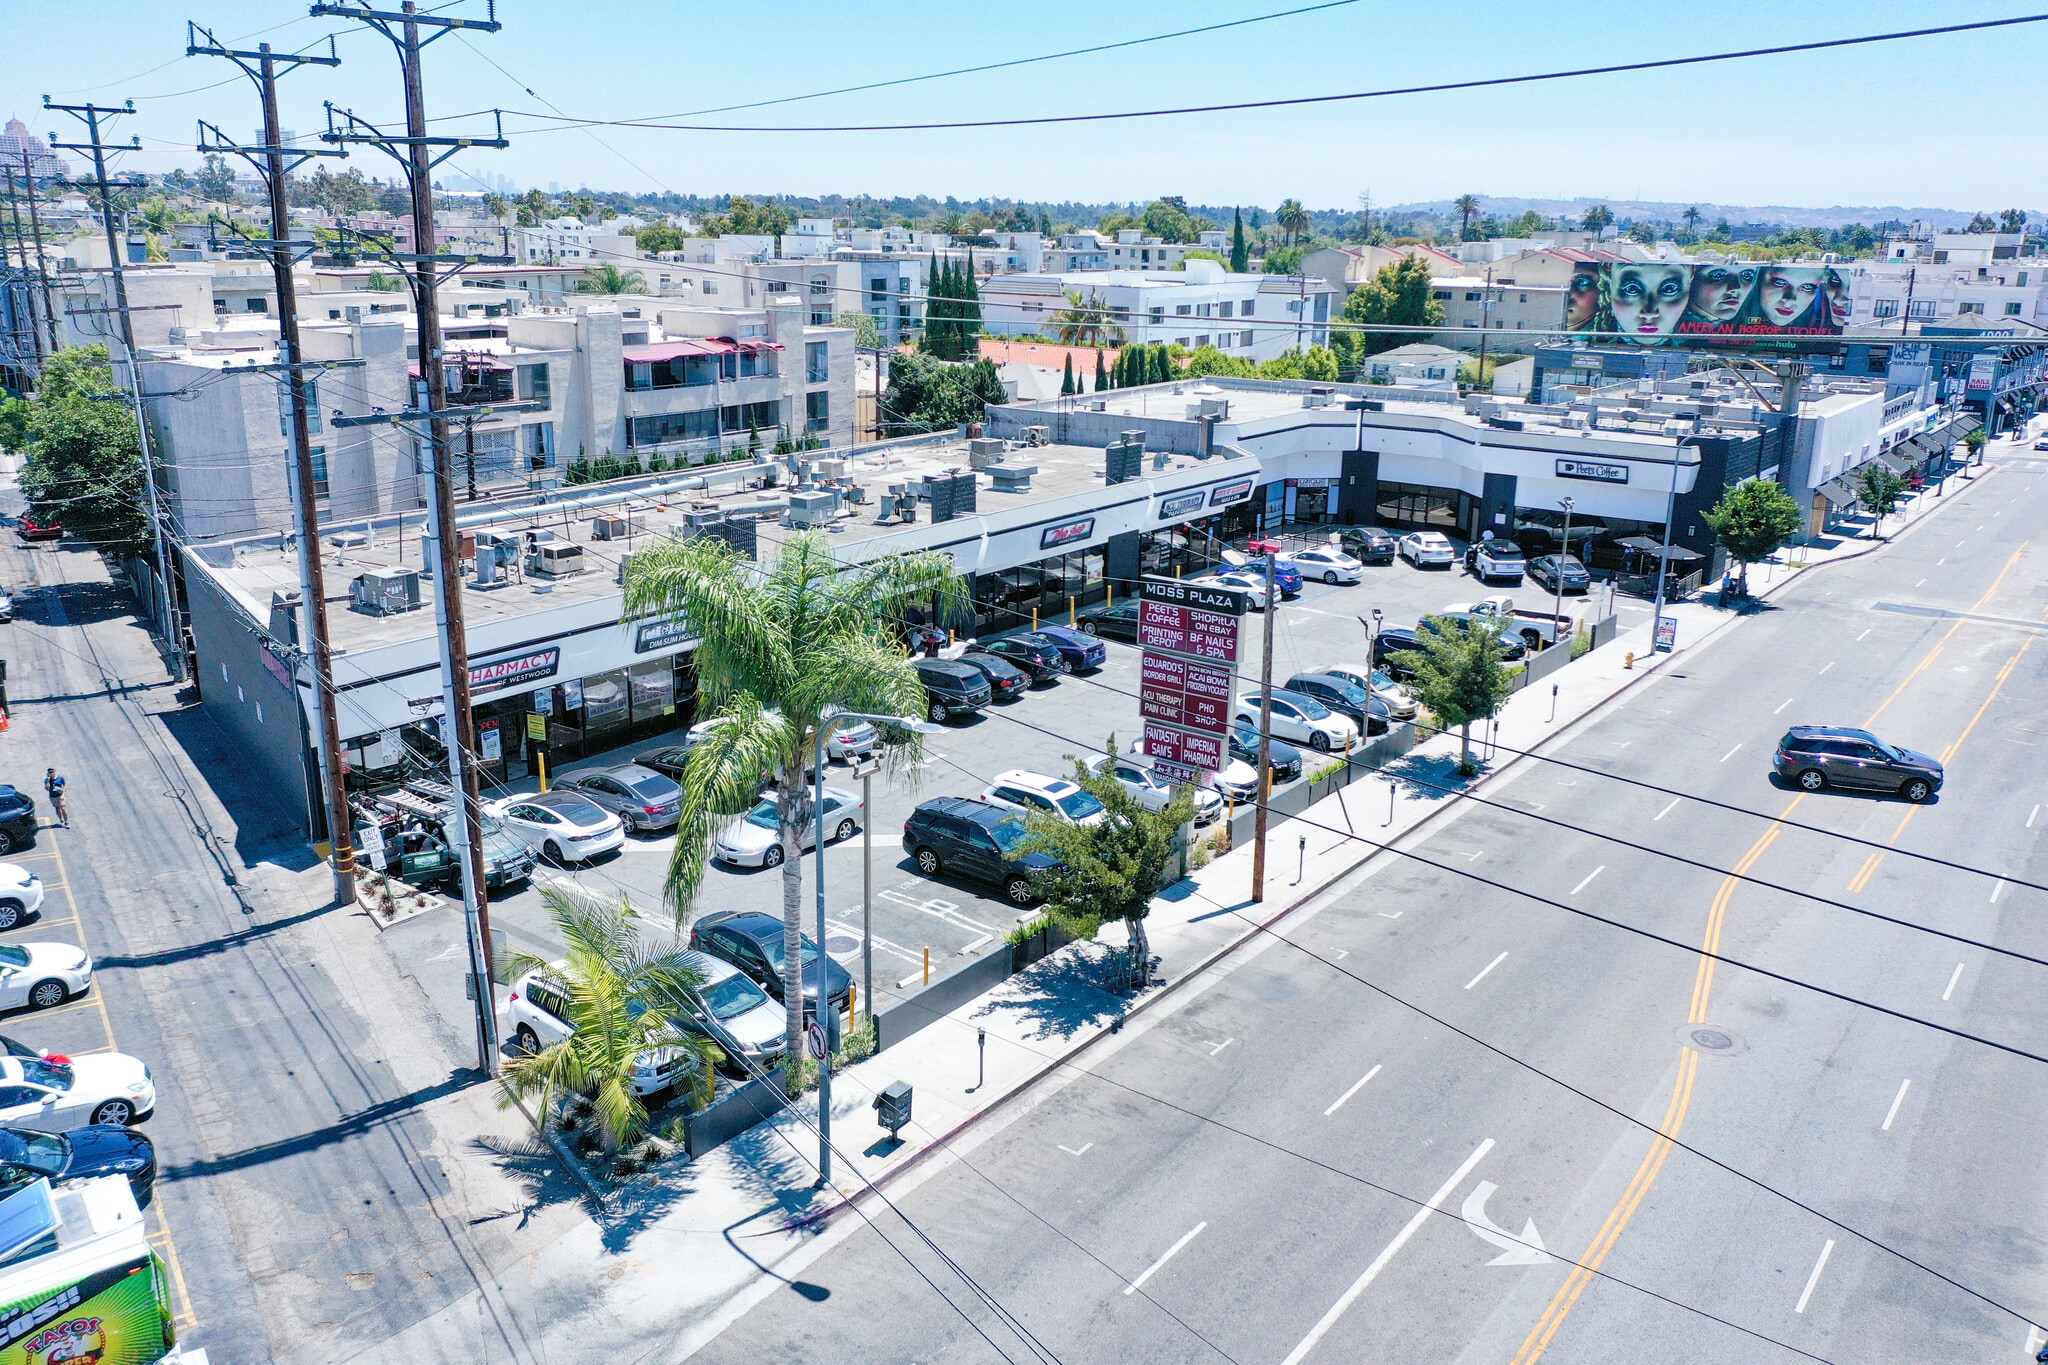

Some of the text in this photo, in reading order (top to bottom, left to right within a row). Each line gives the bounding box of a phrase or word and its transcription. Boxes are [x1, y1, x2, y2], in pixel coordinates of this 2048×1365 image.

[1680, 322, 1735, 334] AMERICAN
[1739, 325, 1782, 335] HORROR
[1894, 350, 1919, 360] WEST
[1596, 466, 1619, 478] Coffee
[1146, 584, 1232, 608] MOSS PLAZA
[1149, 603, 1179, 616] PEET'S
[1146, 613, 1180, 626] COFFEE
[1191, 612, 1236, 628] SHOPitLA
[1142, 625, 1183, 641] PRINTING
[1195, 622, 1232, 635] ON EBAY
[649, 640, 663, 649] DIM
[663, 636, 678, 645] SUM
[679, 630, 700, 640] HOUE
[1147, 636, 1177, 648] DEPOT
[1190, 632, 1233, 649] BF NAILS
[1196, 645, 1225, 659] & SPA
[469, 652, 553, 682] HARMACY
[1144, 657, 1183, 674] EDUARDO'S
[509, 667, 551, 683] WESTWOOD
[1144, 670, 1182, 685] BORDER GRILL
[1188, 672, 1229, 687] ACAI BOWL
[1187, 681, 1228, 697] FROZEN YOGURT
[1143, 690, 1182, 706] ACU THERAPY
[1144, 702, 1178, 718] PAIN CLINIC
[1199, 702, 1214, 713] PHO
[1195, 714, 1217, 726] SHOP
[1146, 727, 1180, 745] FANTASTIC
[1151, 743, 1172, 758] SAM'S
[1187, 737, 1217, 754] IMPERIAL
[1183, 749, 1220, 768] PHARMACY
[364, 834, 378, 842] ONLY
[24, 1318, 102, 1353] TACOS
